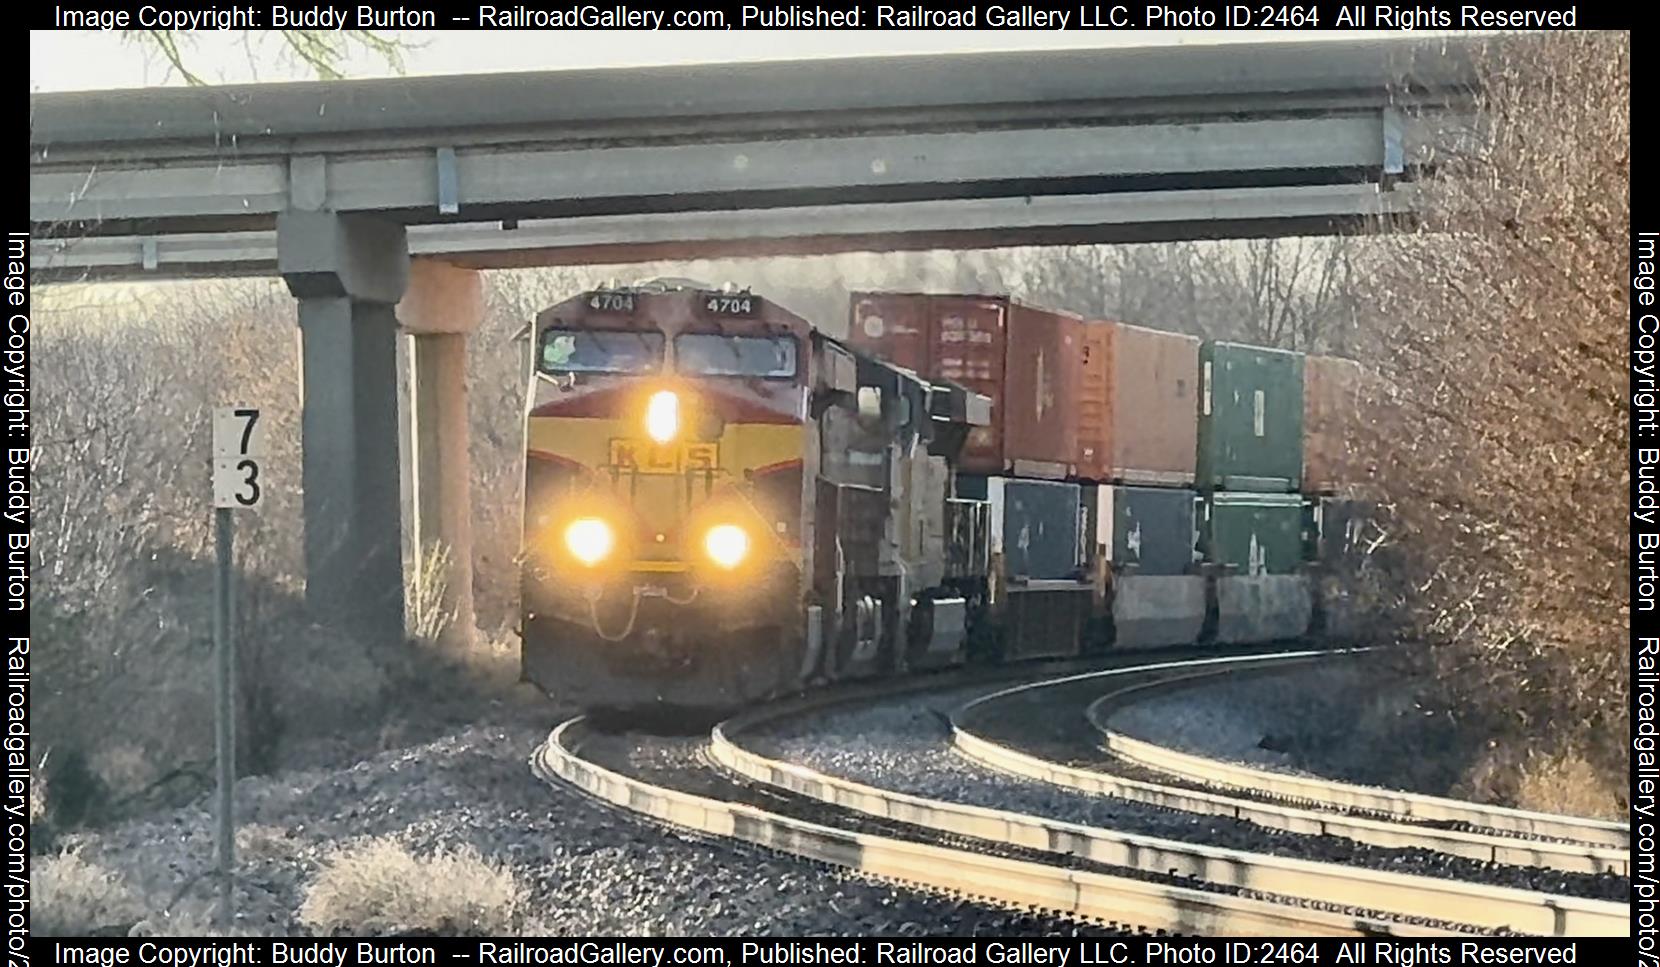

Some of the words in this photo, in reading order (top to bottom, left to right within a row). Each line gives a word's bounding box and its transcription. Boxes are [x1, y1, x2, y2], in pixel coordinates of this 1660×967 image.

[590, 295, 634, 311] 4704
[708, 299, 752, 313] 4704
[234, 410, 260, 455] 7
[235, 459, 260, 506] 3
